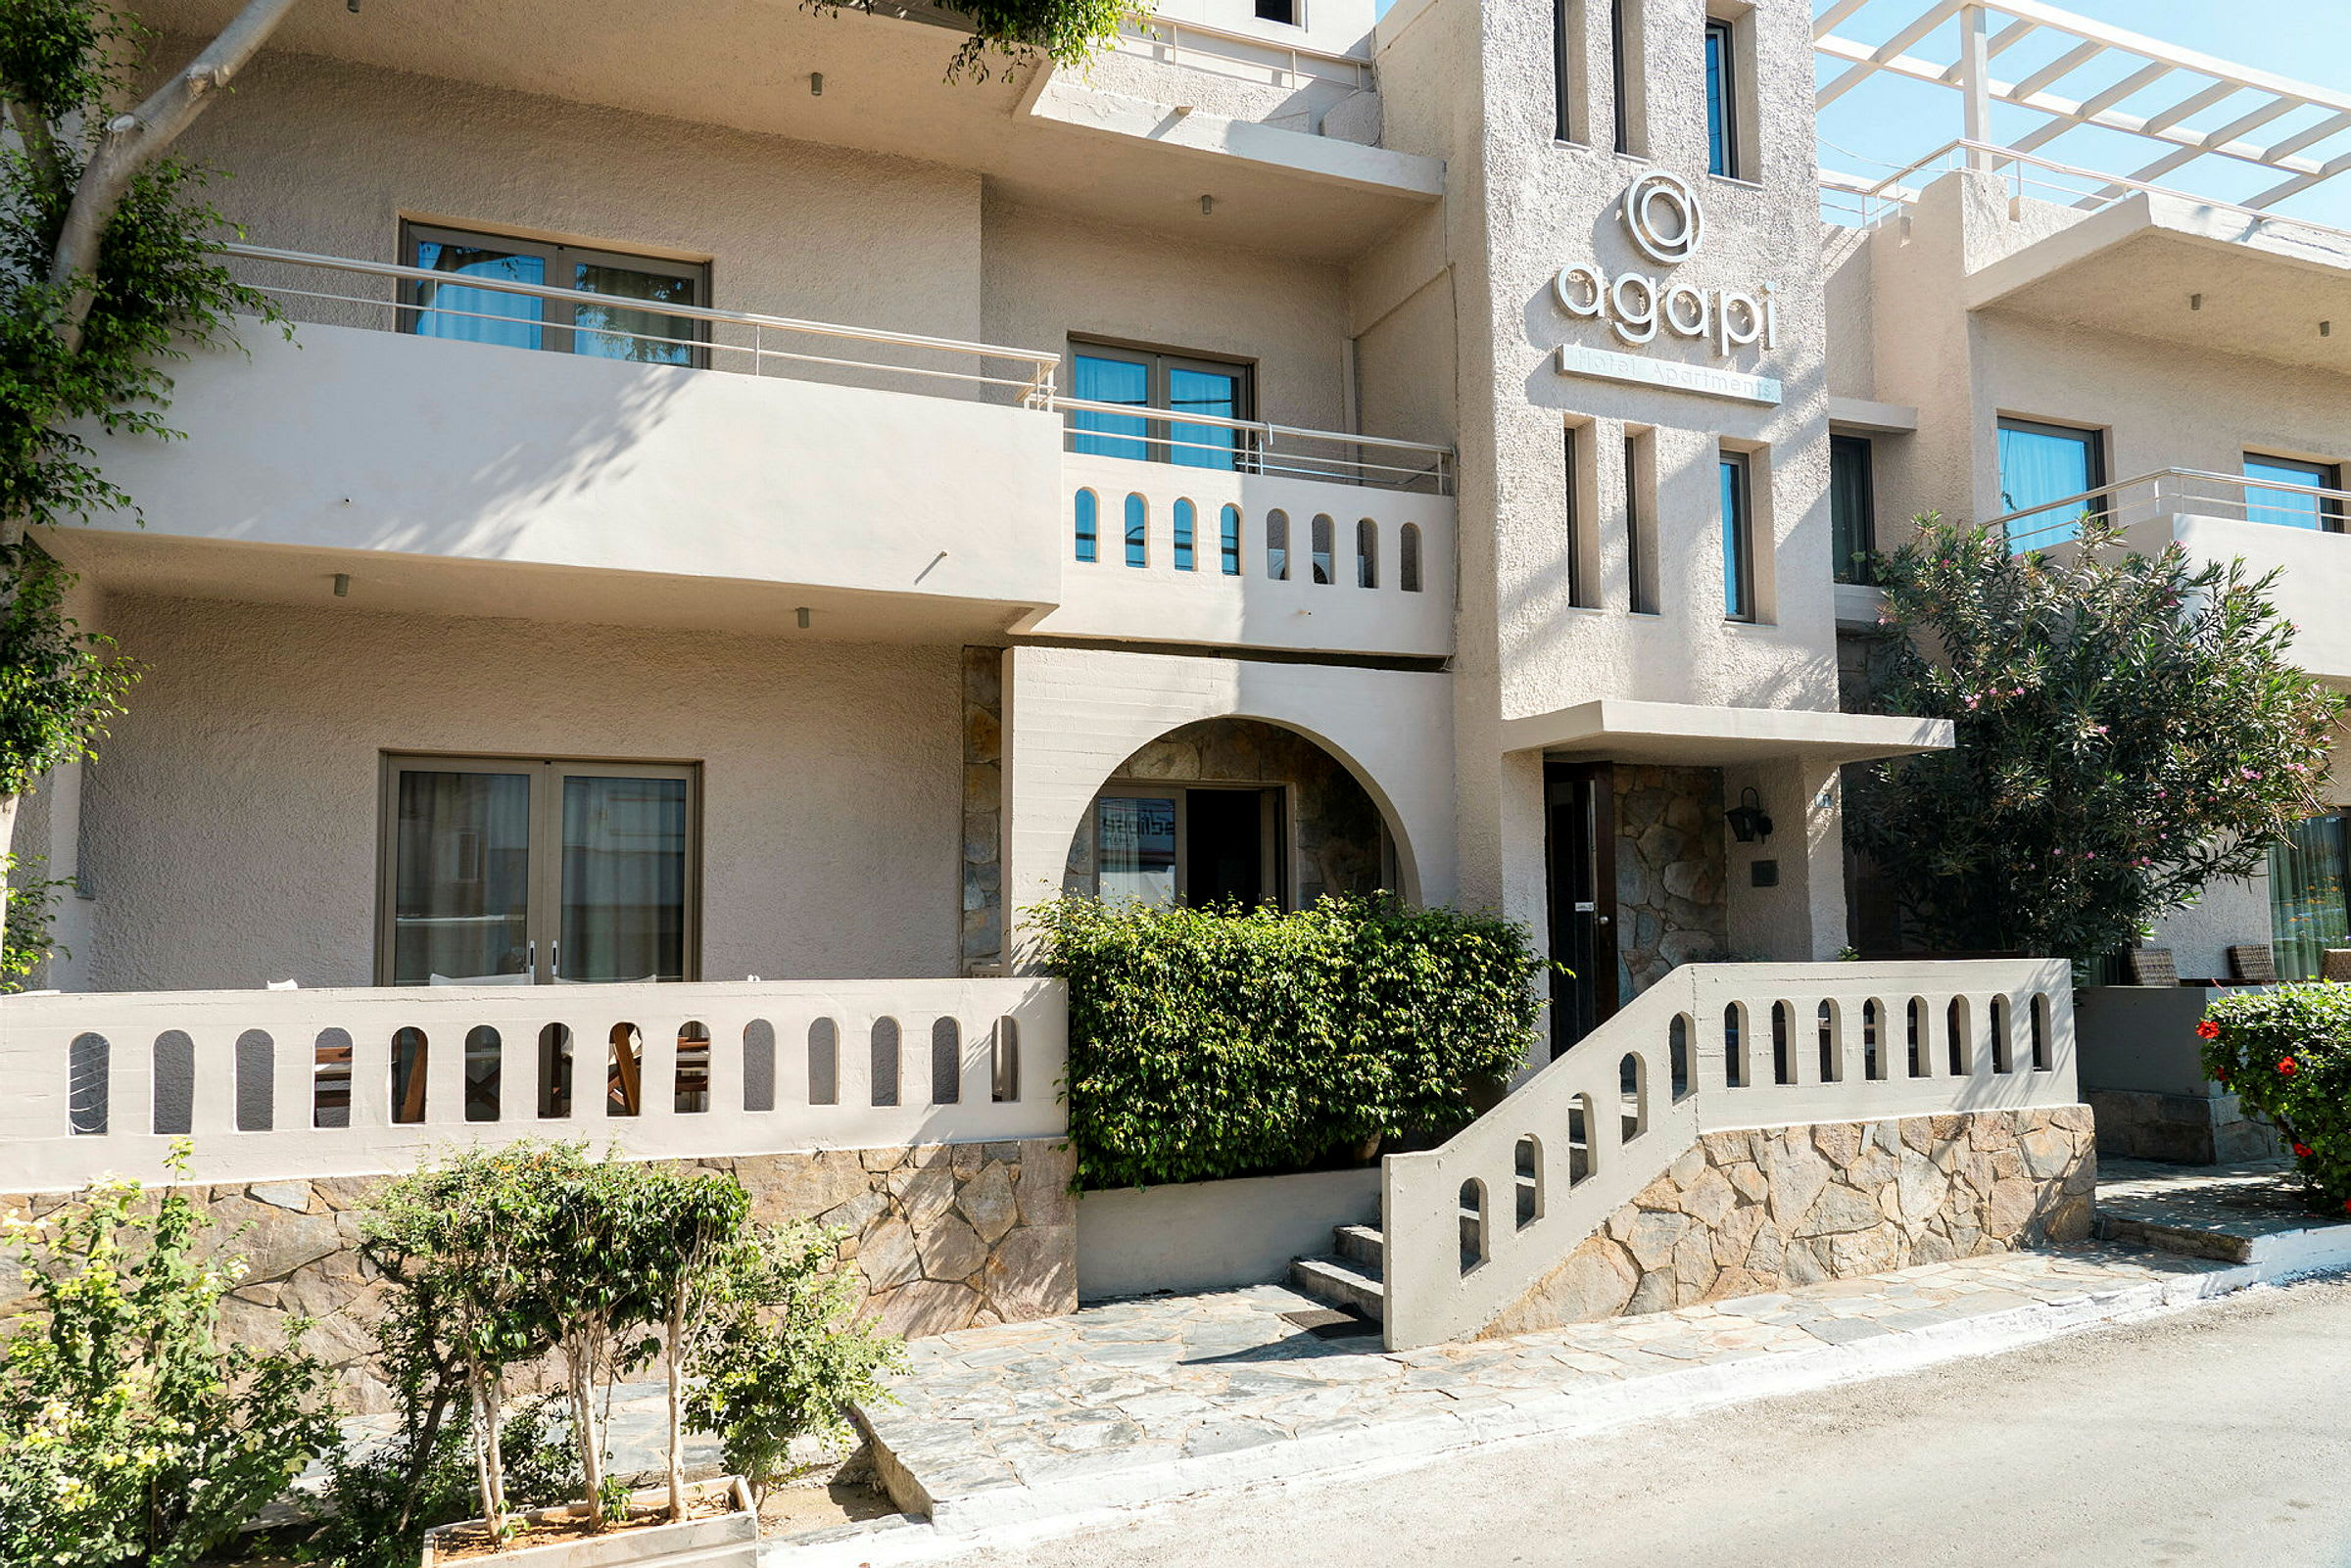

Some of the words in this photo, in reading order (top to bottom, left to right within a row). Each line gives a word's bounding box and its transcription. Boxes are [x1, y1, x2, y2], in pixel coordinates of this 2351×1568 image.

[1558, 261, 1777, 357] agapi
[1577, 349, 1636, 376] Hotel
[1655, 361, 1773, 398] Apartments
